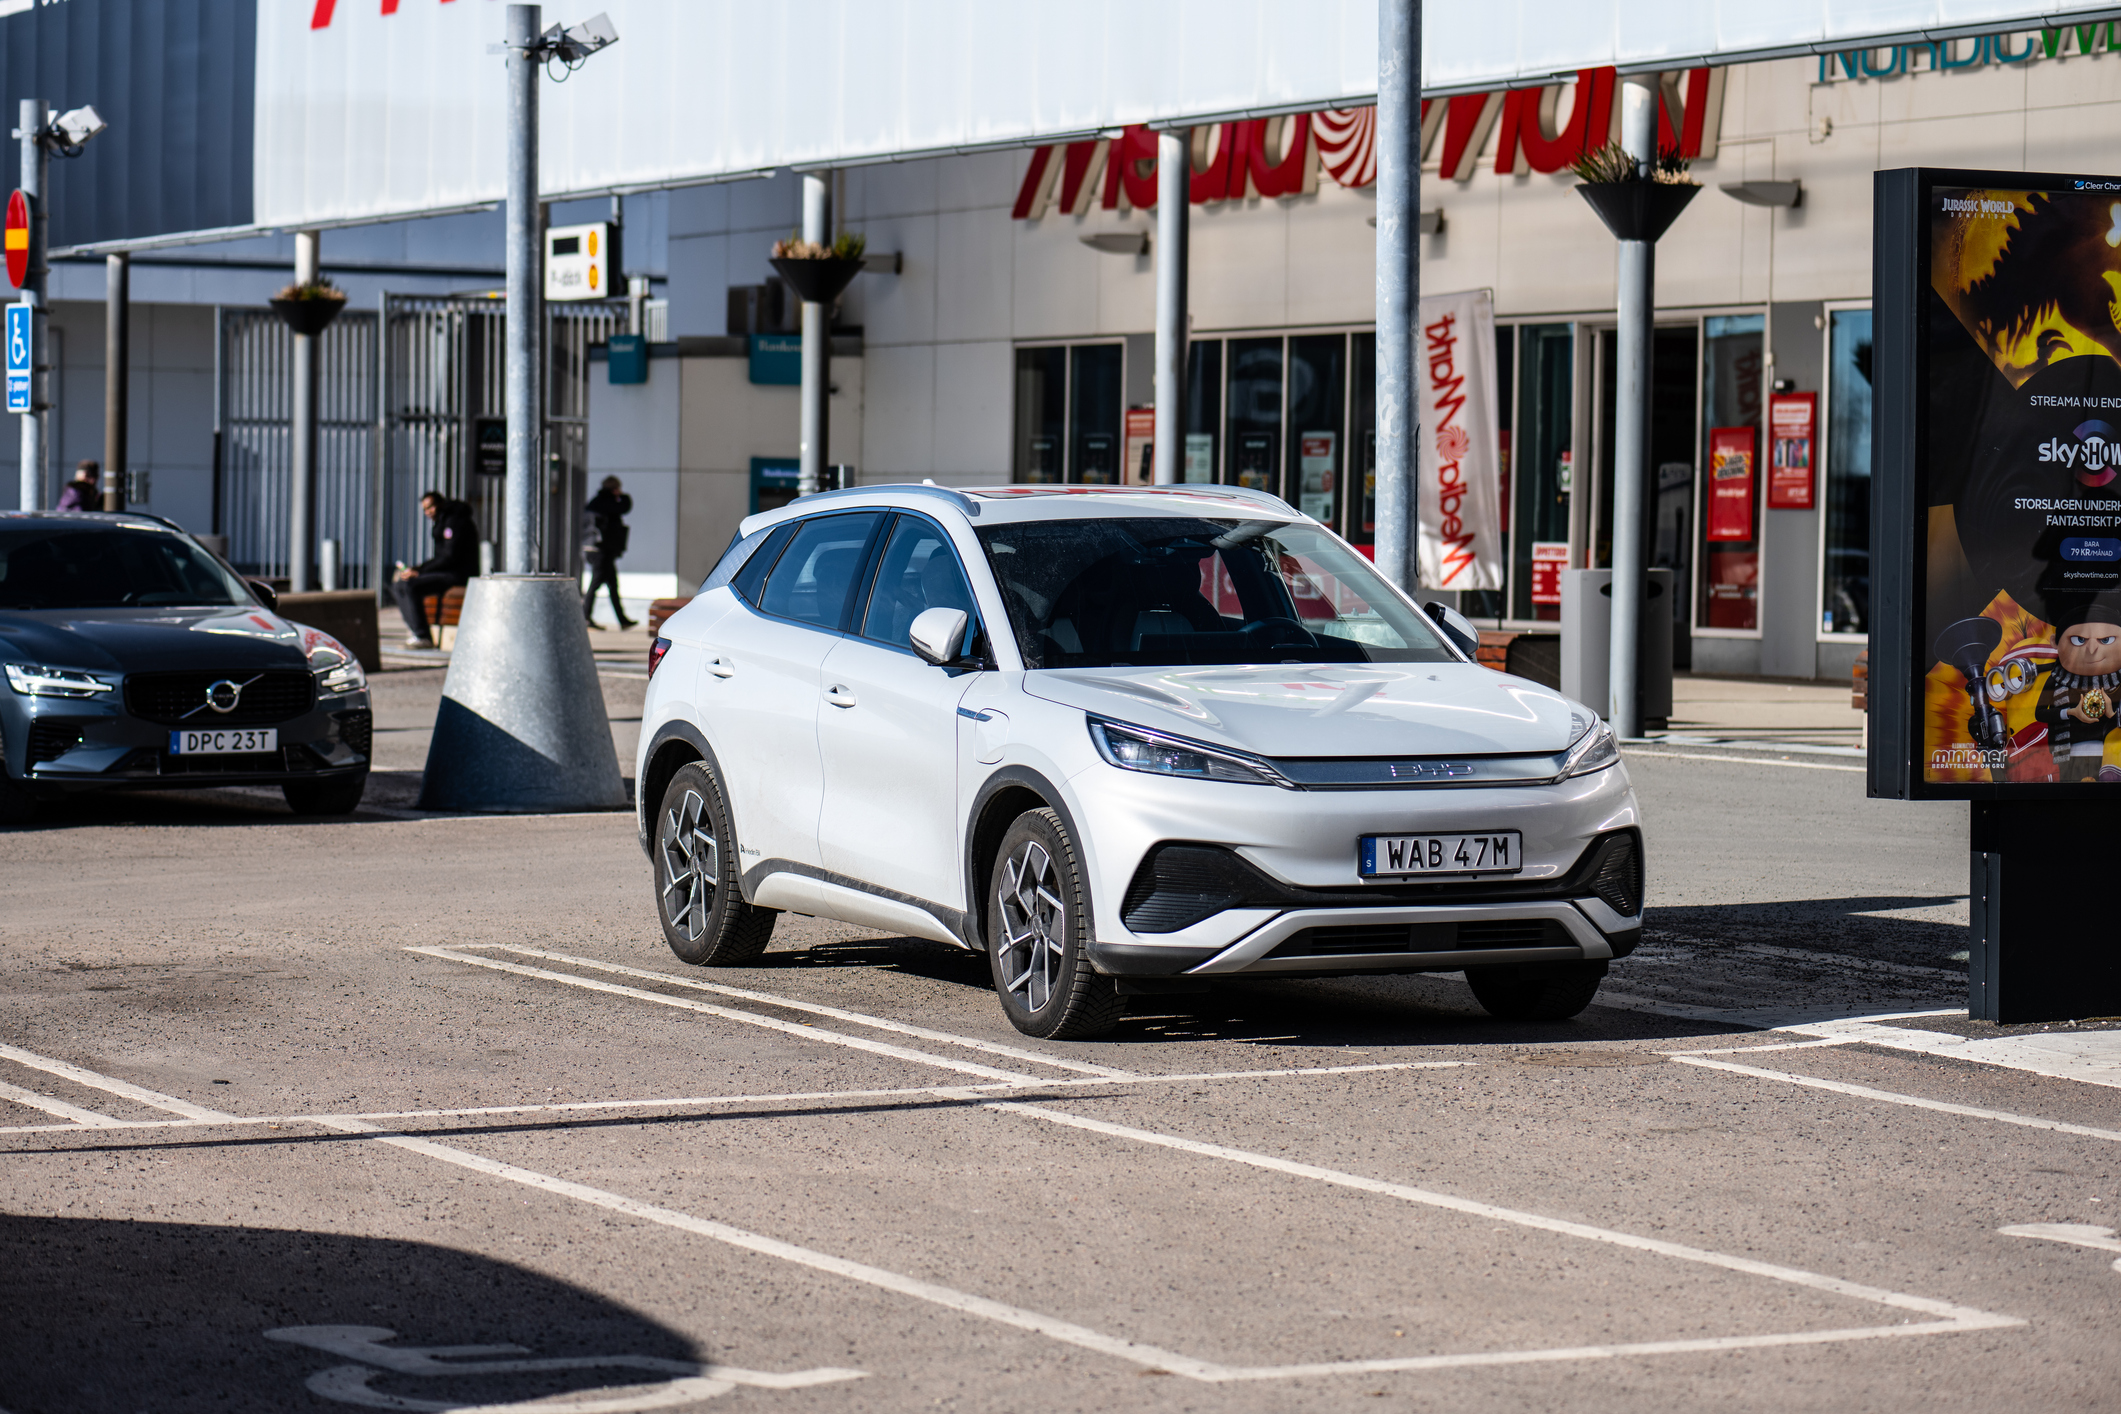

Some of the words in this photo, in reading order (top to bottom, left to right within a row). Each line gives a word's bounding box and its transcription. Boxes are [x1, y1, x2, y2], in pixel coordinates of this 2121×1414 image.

[2085, 181, 2104, 190] Clear
[1942, 198, 1979, 212] JURASSIC
[1980, 200, 2015, 214] WORLD
[2030, 395, 2080, 407] STREAMA
[2083, 397, 2099, 408] NU
[2014, 498, 2082, 510] STORSLAGEN
[2046, 515, 2113, 527] FANTASTISKT
[2071, 548, 2079, 556] 79
[2080, 547, 2113, 557] KR/MÅNAD
[2063, 571, 2119, 579] skyshowtime.com
[188, 733, 225, 751] DPC
[232, 731, 269, 750] 23T
[1932, 749, 2008, 763] minioner
[1391, 763, 1474, 777] BYD
[1366, 859, 1372, 867] S
[1387, 839, 1443, 869] WAB
[1453, 837, 1509, 867] 47M
